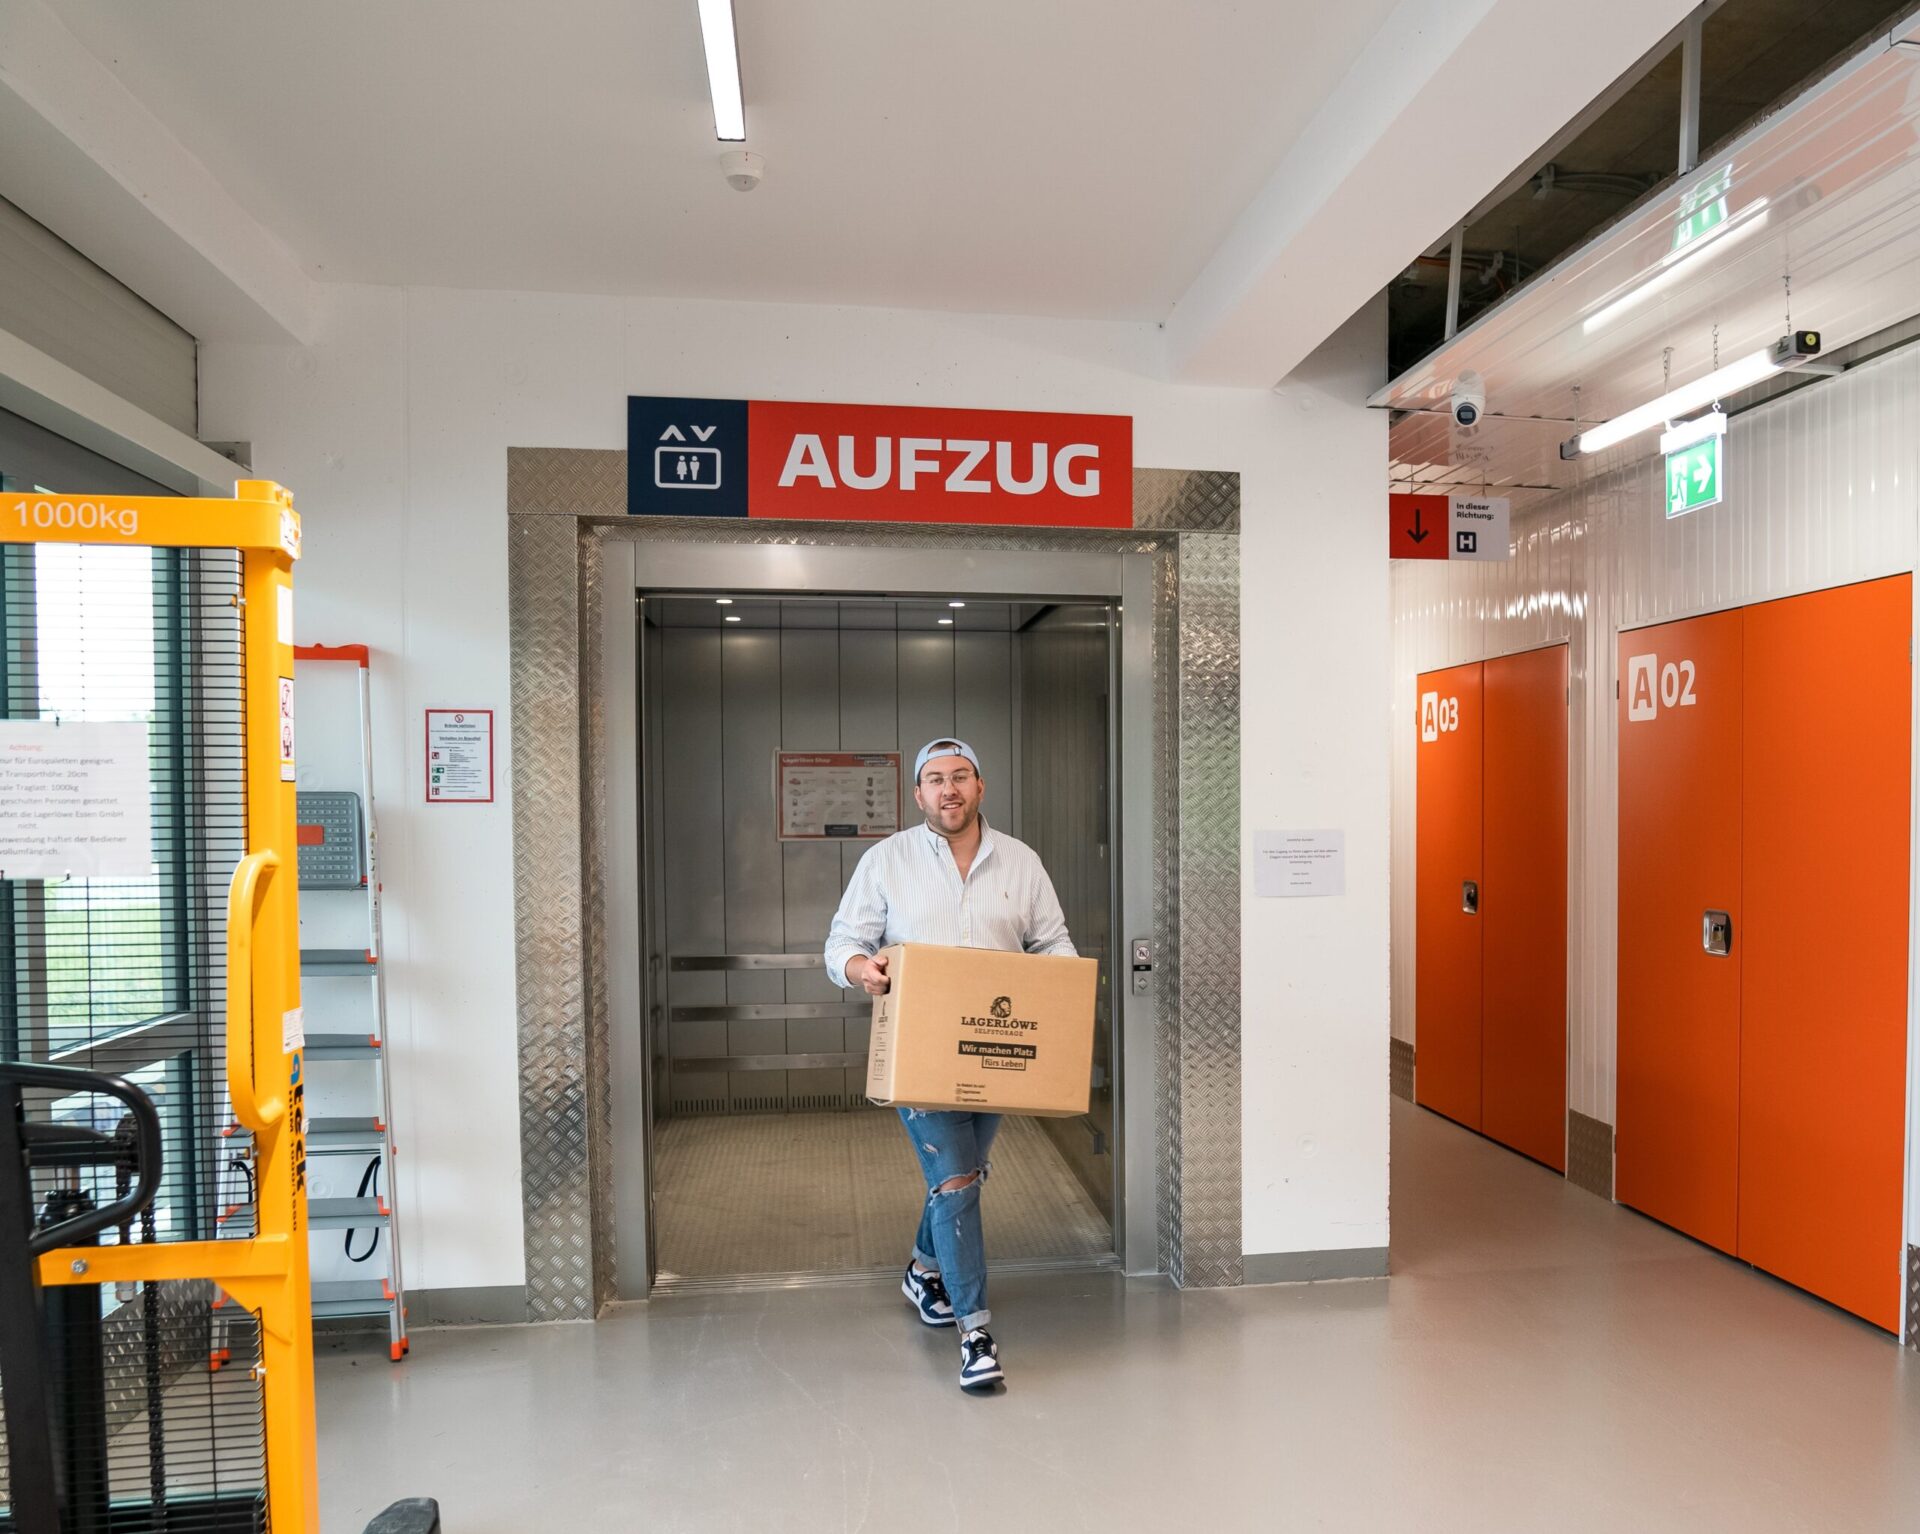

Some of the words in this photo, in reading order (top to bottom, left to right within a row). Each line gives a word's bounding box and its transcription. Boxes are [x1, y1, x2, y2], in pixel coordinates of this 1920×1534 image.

[776, 433, 1101, 498] AUFZUG
[1456, 502, 1465, 510] In
[1466, 502, 1490, 510] dieser
[13, 500, 139, 536] 1000kg
[1456, 511, 1495, 521] Richtung:
[1459, 534, 1474, 550] H
[15, 757, 26, 765] für
[28, 757, 78, 766] Europaletten
[51, 784, 79, 793] 1000kg
[45, 797, 80, 805] Personen
[75, 810, 98, 818] Essen
[99, 810, 124, 818] GmbH
[74, 835, 87, 843] der
[90, 835, 127, 843] Bediener
[960, 1016, 1039, 1031] LAGERLÖWE
[974, 1027, 1024, 1037] SELFSTORAGE
[961, 1043, 978, 1053] Wir
[979, 1045, 1012, 1056] machen
[1013, 1046, 1035, 1057] Platz
[984, 1058, 1000, 1067] fürs
[1001, 1058, 1024, 1068] Leben
